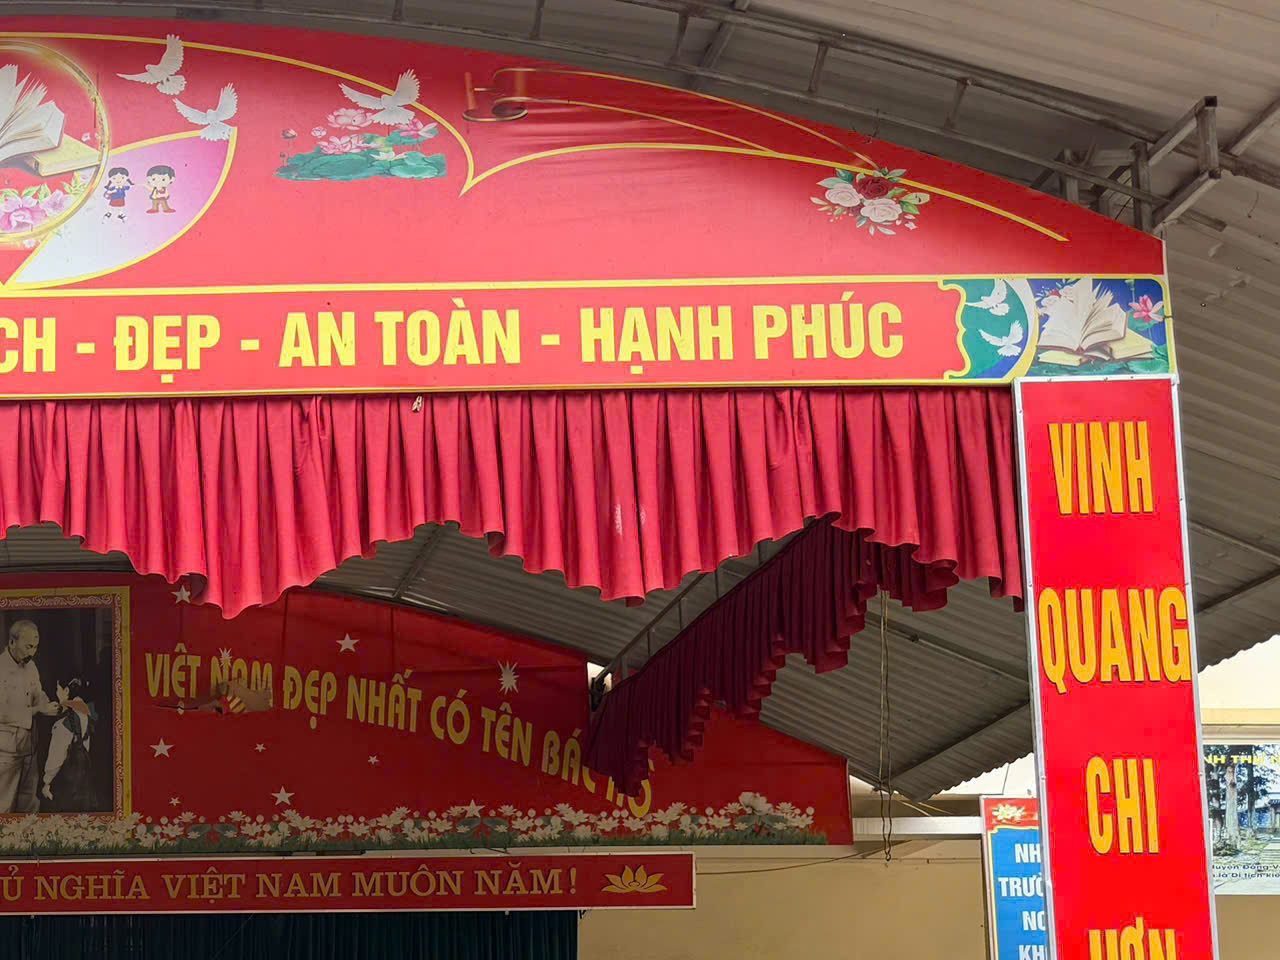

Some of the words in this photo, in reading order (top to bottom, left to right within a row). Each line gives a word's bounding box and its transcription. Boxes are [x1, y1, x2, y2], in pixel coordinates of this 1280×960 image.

[114, 314, 222, 384] ĐẸP
[278, 311, 357, 368] AN
[375, 298, 521, 367] TOÀN
[580, 305, 731, 375] HẠNH
[753, 291, 905, 361] PHÚC
[1048, 420, 1154, 515] VINH
[1038, 586, 1193, 694] QUANG
[144, 643, 201, 715] VIỆT
[282, 665, 337, 730] ĐẸP
[346, 670, 424, 734] NHẤT
[429, 689, 471, 744] CÓ
[481, 705, 533, 767] TÊN
[1014, 843, 1042, 863] NH
[1085, 756, 1159, 855] CHI
[34, 869, 149, 901] NGHĨA
[162, 866, 247, 904] VIỆT
[255, 872, 340, 898] NAM
[351, 865, 465, 897] MUÔN
